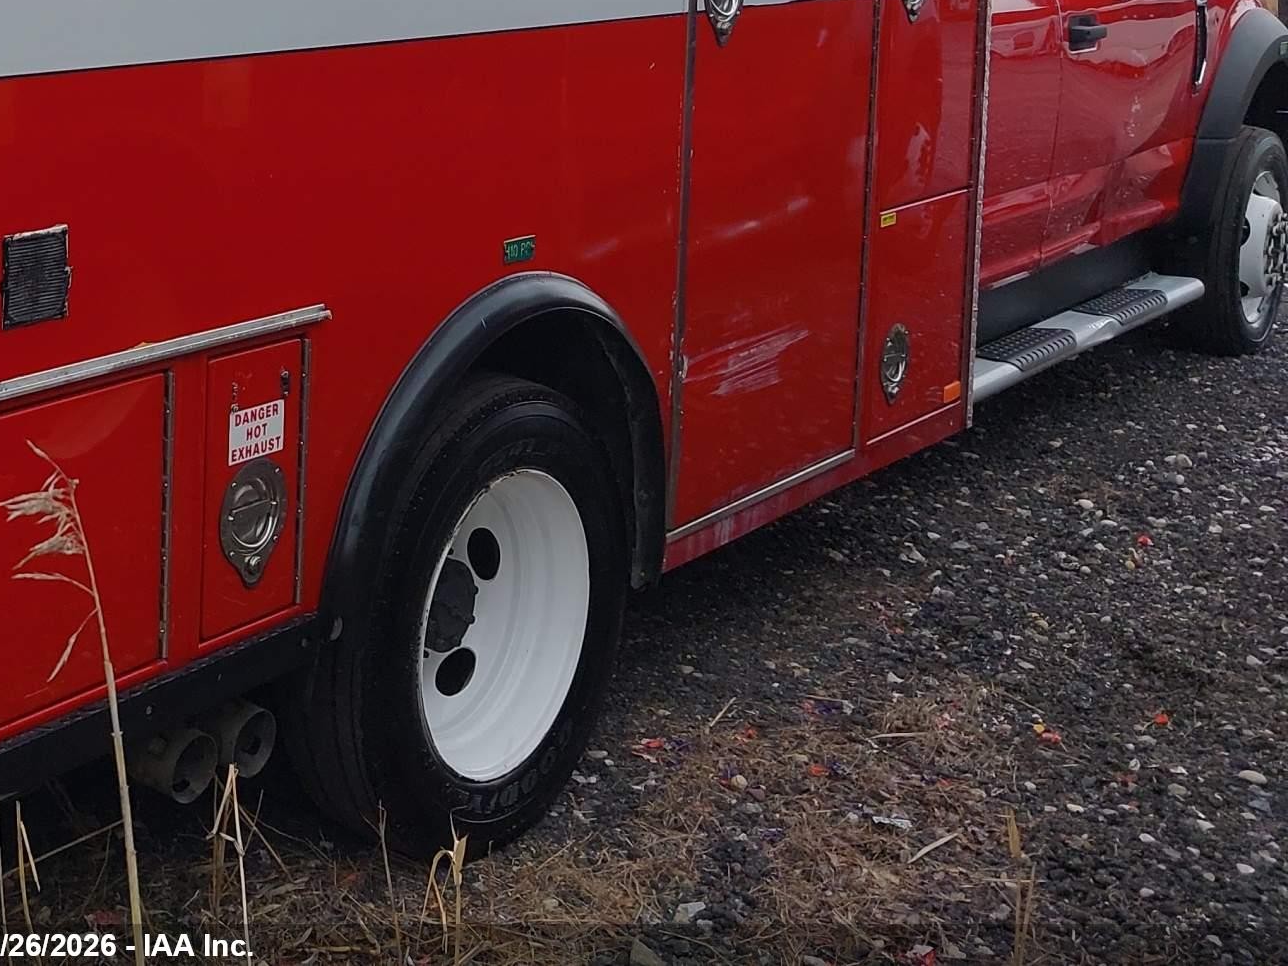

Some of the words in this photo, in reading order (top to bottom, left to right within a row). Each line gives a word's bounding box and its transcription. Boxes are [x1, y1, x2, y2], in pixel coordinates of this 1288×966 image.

[234, 403, 279, 427] DANGER
[246, 423, 268, 441] HOT
[231, 436, 281, 462] EXHAUST
